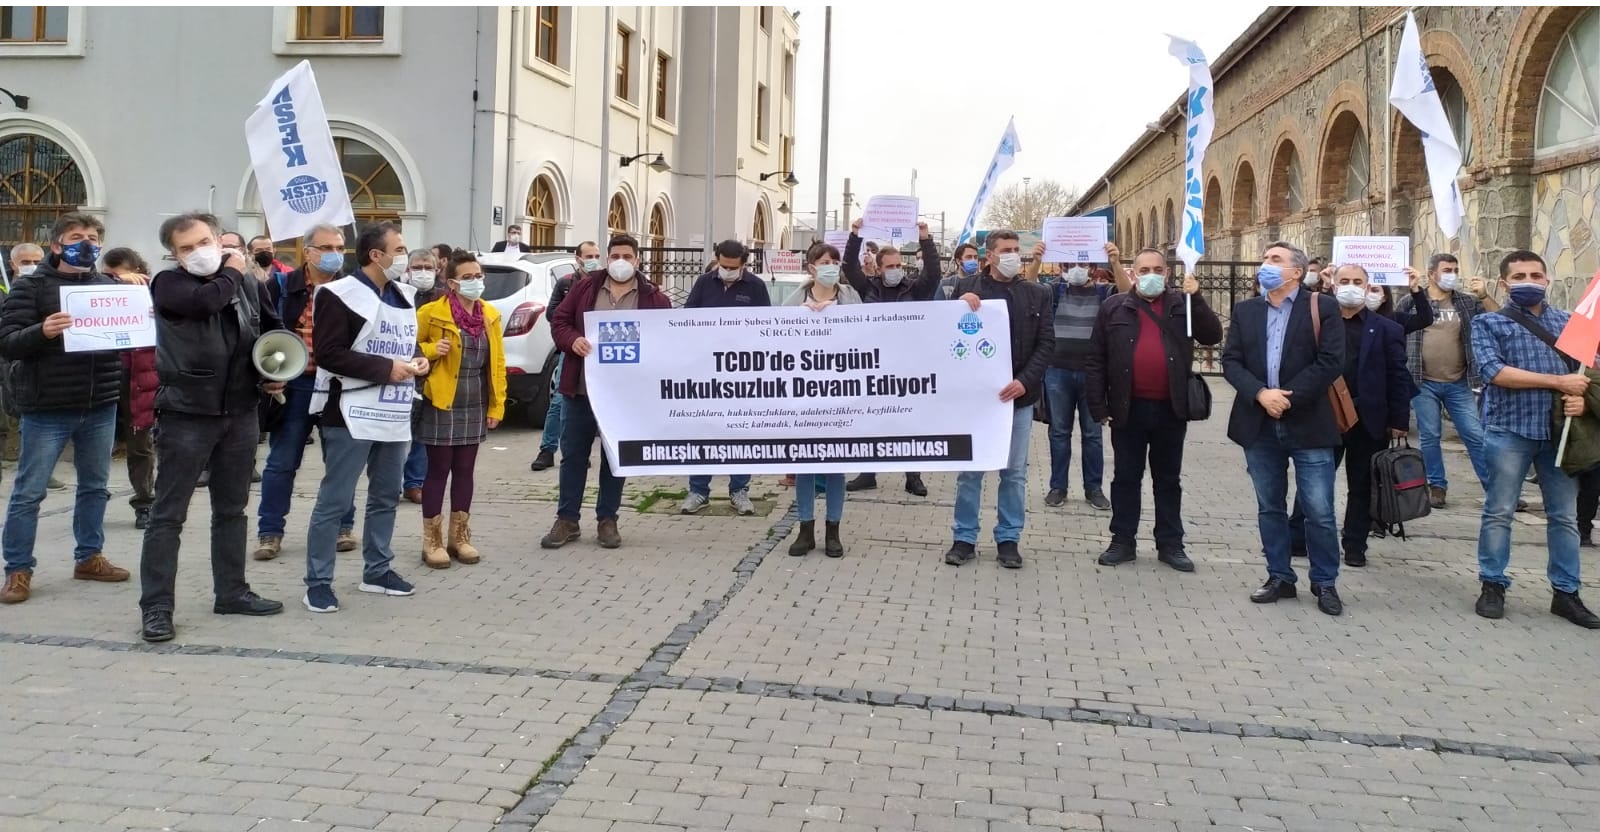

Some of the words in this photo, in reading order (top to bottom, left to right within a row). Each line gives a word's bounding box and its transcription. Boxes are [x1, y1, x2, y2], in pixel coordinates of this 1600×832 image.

[280, 181, 329, 201] KESK
[90, 296, 129, 308] BTS'YE
[74, 314, 144, 328] DOKUNMA!
[668, 318, 716, 328] Sendikamız
[719, 317, 742, 327] İzmir
[744, 316, 772, 328] Şubesi
[774, 315, 809, 326] Yönetici
[822, 315, 863, 325] Temsilcisi
[865, 314, 870, 323] 4
[872, 313, 925, 323] arkadaşımız
[957, 322, 983, 331] KESK
[759, 327, 801, 338] SÜRGÜN
[804, 327, 833, 337] Edildi!
[602, 345, 636, 361] BTS
[713, 350, 795, 373] TCDD'de
[800, 348, 880, 373] Sürgün!
[383, 385, 413, 402] BTS
[660, 377, 788, 400] Hukuksuzluk
[793, 376, 861, 398] Devam
[866, 373, 937, 398] Ediyor!
[669, 409, 725, 418] Haksızlıklara,
[727, 408, 798, 418] hukuksuzluklara,
[800, 407, 865, 416] adaletsizliklere,
[867, 406, 913, 415] keyfiliklere
[726, 420, 749, 429] sessiz
[751, 419, 791, 429] kalmadık,
[794, 418, 853, 429] kalmayacağız!
[642, 443, 700, 463] BİRLEŞİK
[702, 443, 787, 463] TAŞIMACILIK
[789, 442, 874, 461] ÇALIŞANLARI
[877, 438, 949, 458] SENDİKASI
